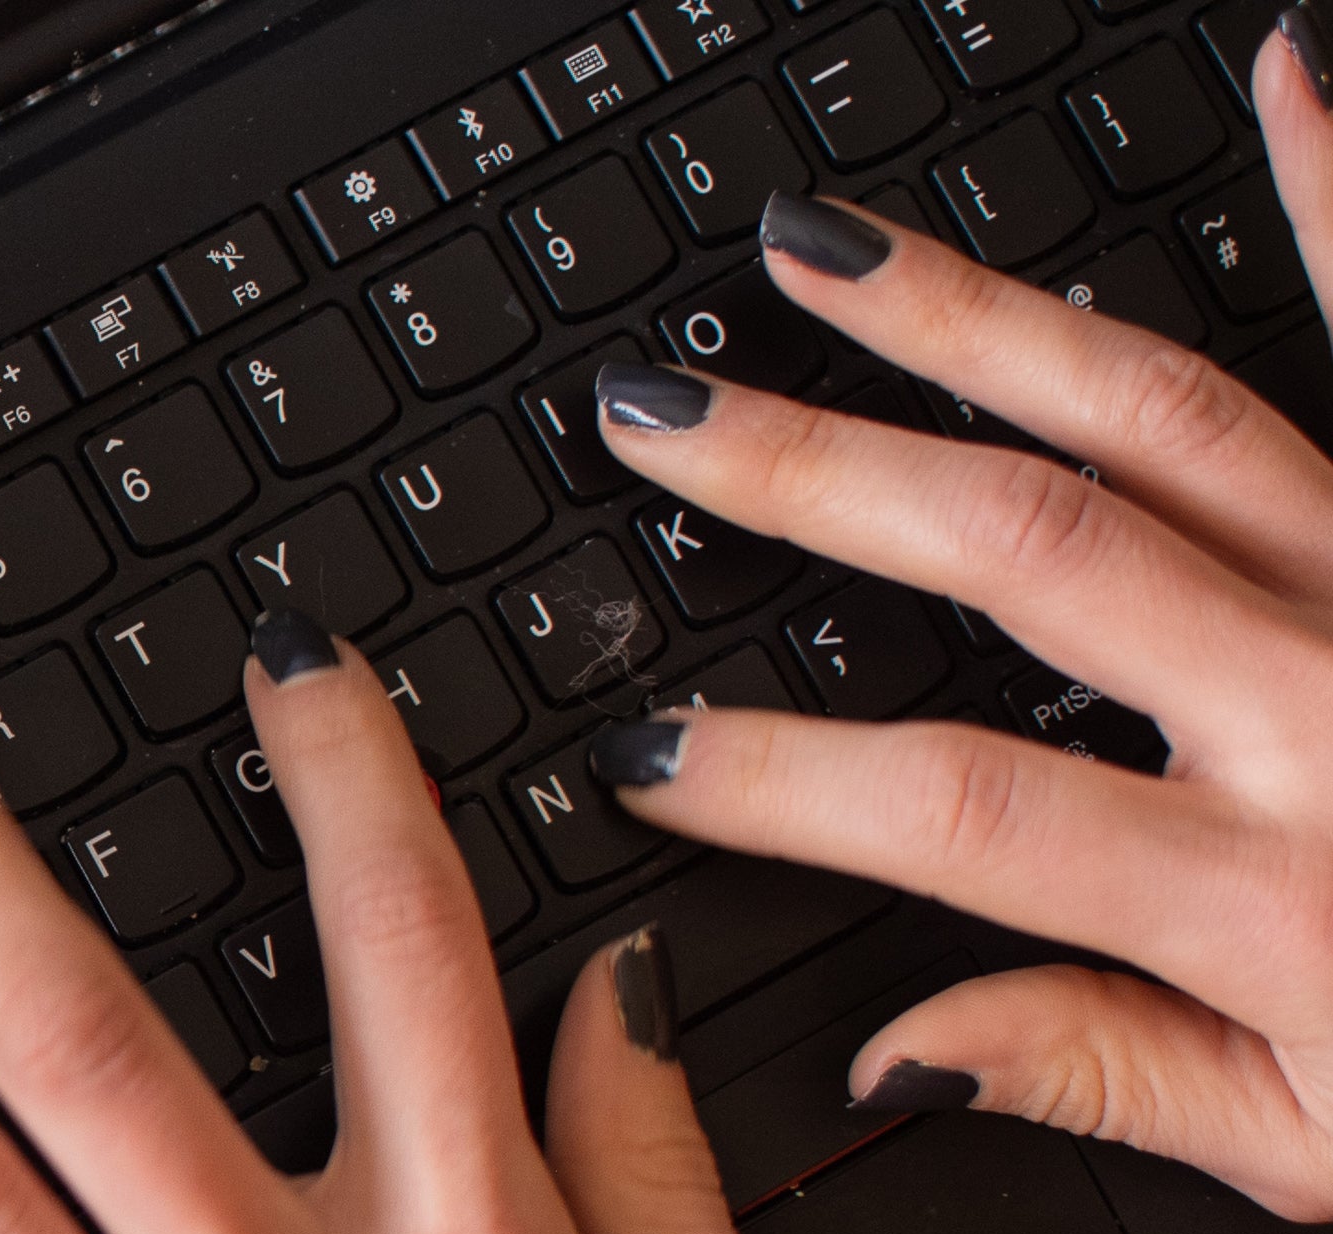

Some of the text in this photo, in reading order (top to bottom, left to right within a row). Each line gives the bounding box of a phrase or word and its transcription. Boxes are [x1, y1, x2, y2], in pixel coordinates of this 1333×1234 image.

[696, 23, 736, 55] F12
[587, 83, 625, 114] F11
[475, 143, 515, 175] F10
[684, 160, 715, 195] 0
[367, 207, 397, 233] F9
[546, 236, 576, 271] 9
[232, 281, 261, 307] F8
[407, 311, 437, 346] 8
[684, 311, 726, 355] O
[115, 343, 143, 369] F7
[2, 405, 32, 431] F6
[262, 388, 287, 424] 7
[540, 397, 566, 436] I
[121, 468, 150, 502] 6
[399, 464, 442, 511] U
[656, 511, 704, 561] K
[253, 541, 292, 587] Y
[529, 593, 554, 638] J
[114, 621, 151, 666] T
[236, 749, 275, 793] G
[527, 774, 574, 824] N
[85, 829, 118, 879] F
[239, 934, 277, 980] V
